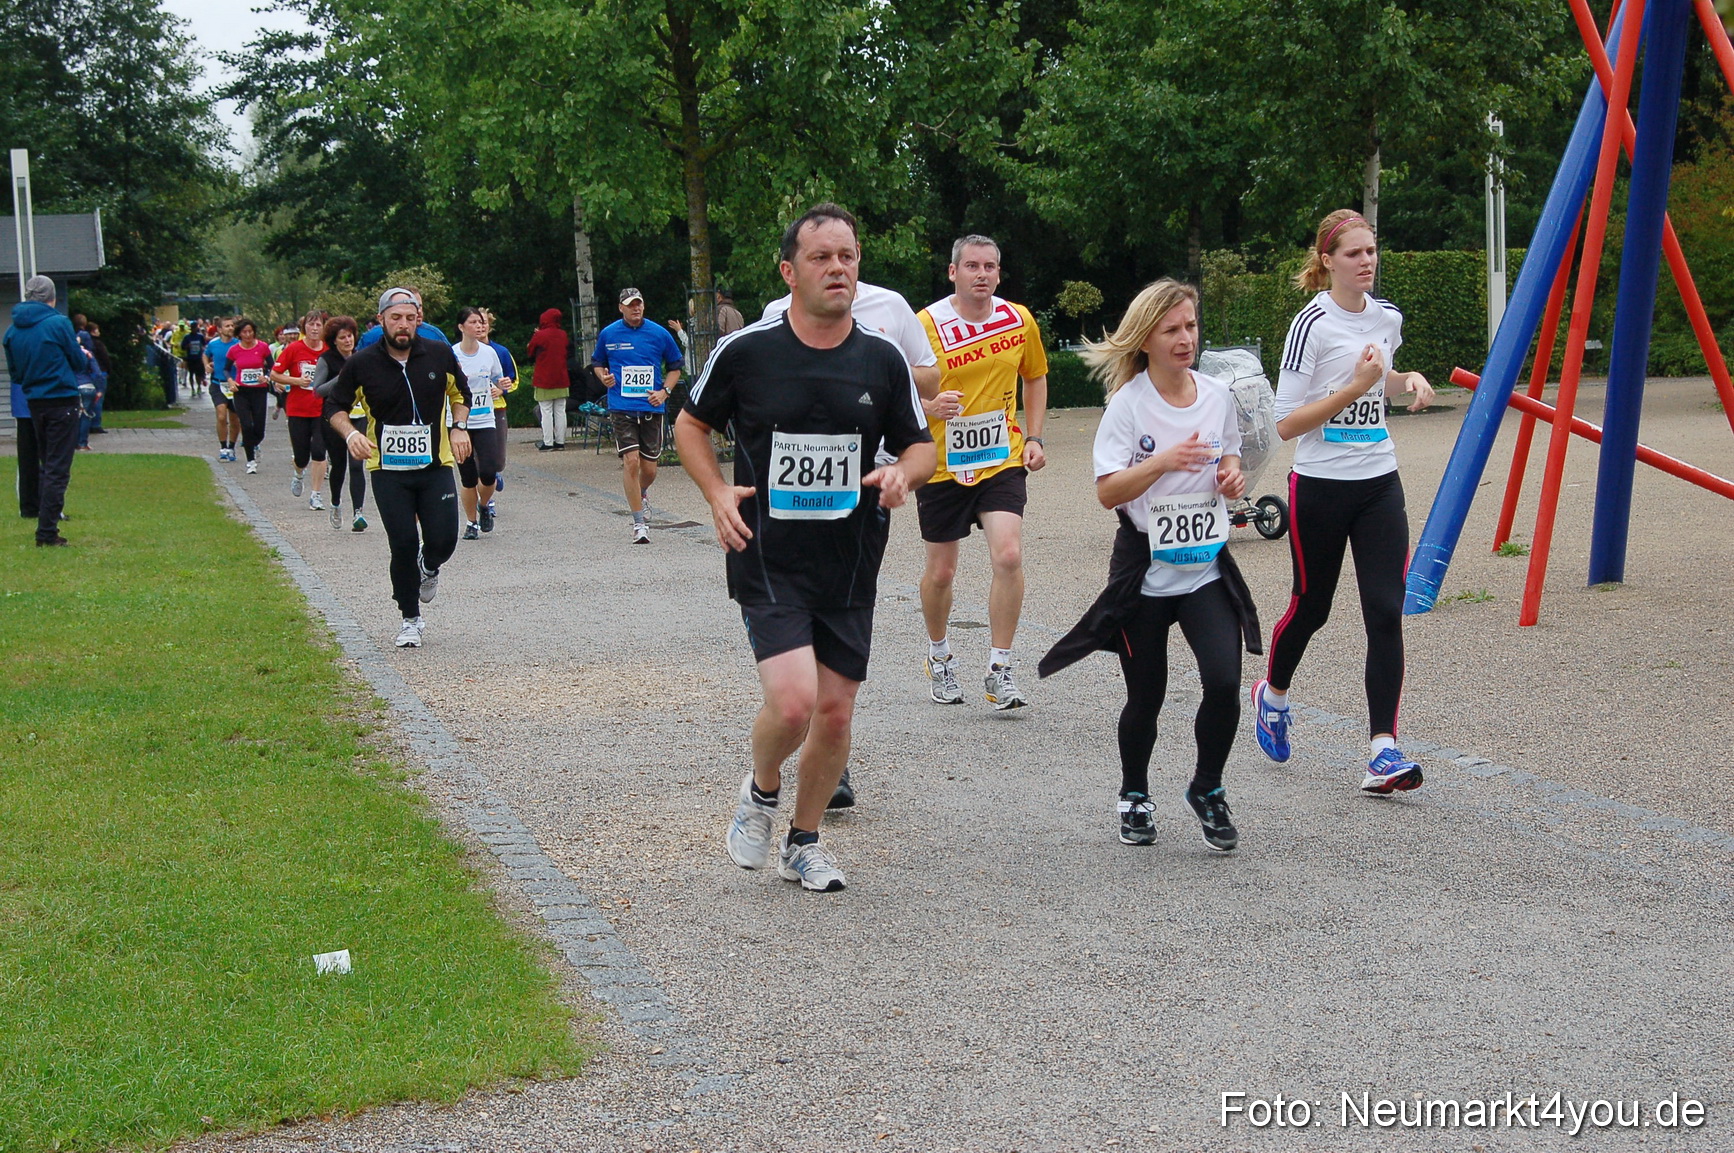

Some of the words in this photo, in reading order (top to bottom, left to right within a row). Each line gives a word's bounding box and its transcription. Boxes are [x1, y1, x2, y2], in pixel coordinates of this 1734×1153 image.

[947, 347, 986, 370] MAX
[990, 333, 1026, 355] BÖGL
[625, 373, 651, 385] 2482
[1329, 401, 1380, 425] 2395
[946, 420, 968, 428] PARTL
[969, 417, 997, 427] Neumarkt
[952, 424, 1002, 450] 3007
[1340, 431, 1371, 441] Marina
[386, 437, 427, 454] 2985
[773, 441, 802, 452] PARTL
[803, 444, 846, 452] Neumarkt
[960, 451, 997, 463] Christian
[777, 455, 849, 487] 2841
[792, 494, 834, 507] Ronald
[1177, 501, 1210, 510] Neumarkt
[1156, 511, 1220, 545] 2862
[1171, 550, 1211, 564] Justyna
